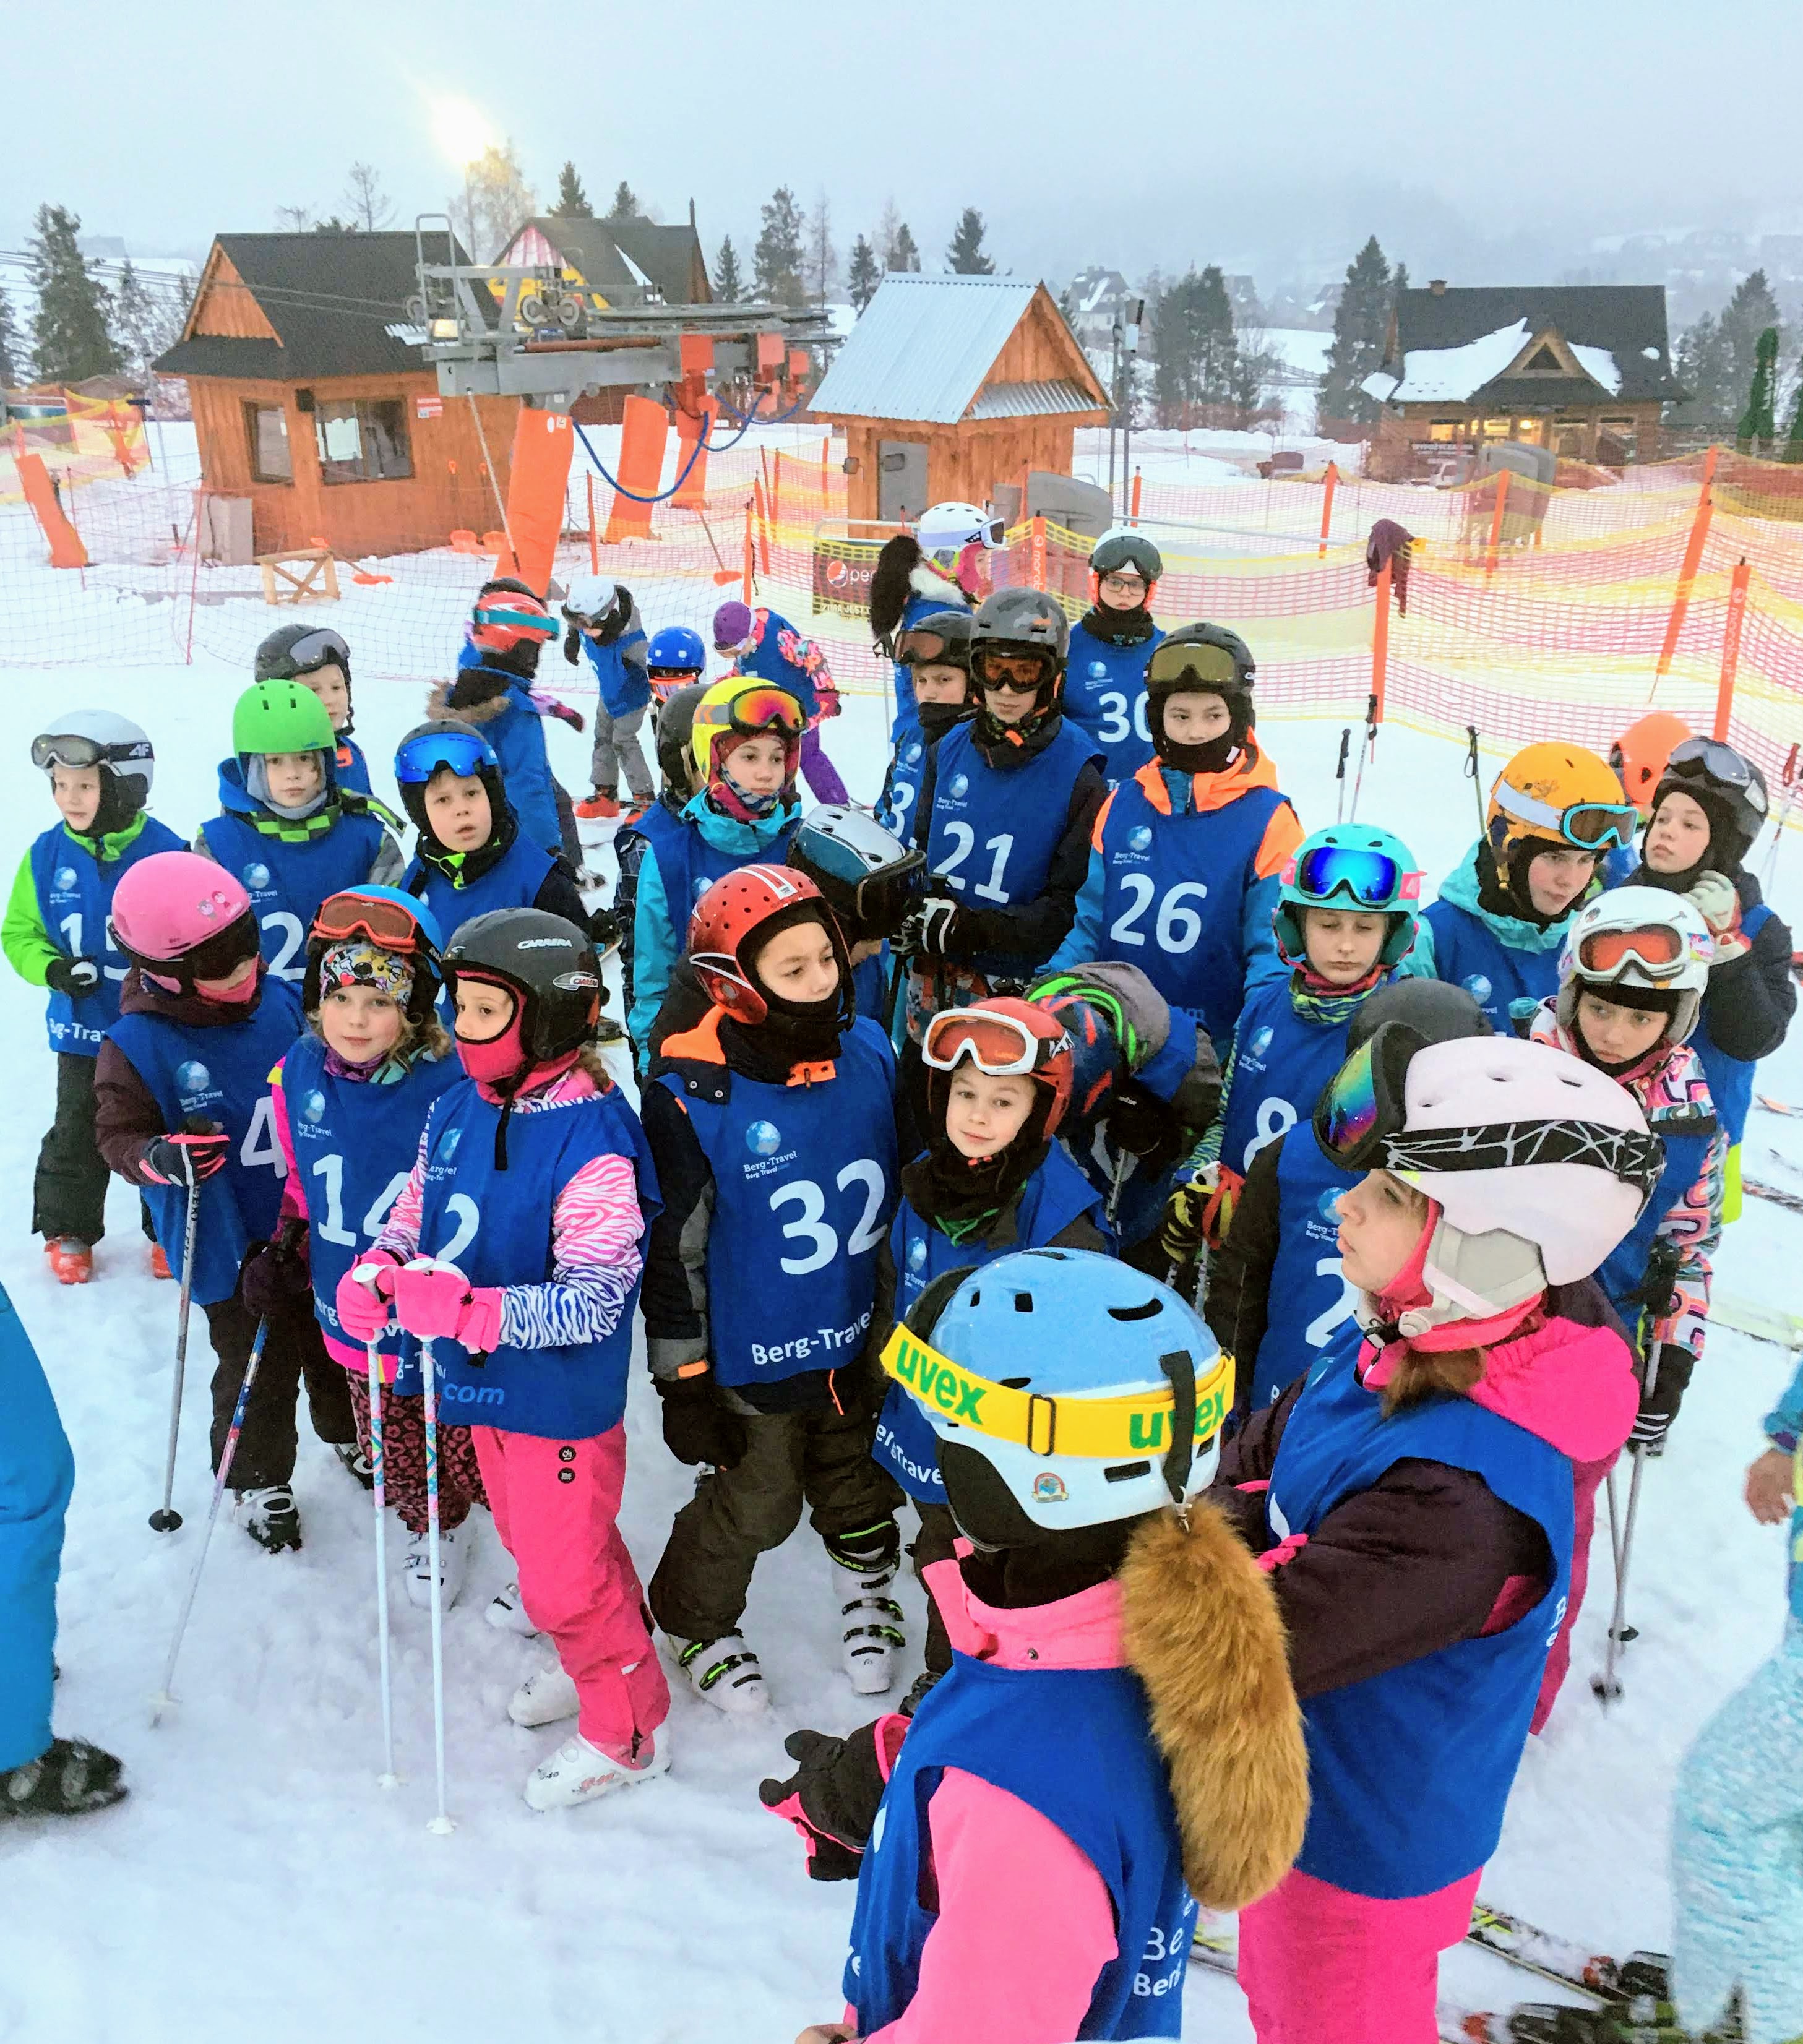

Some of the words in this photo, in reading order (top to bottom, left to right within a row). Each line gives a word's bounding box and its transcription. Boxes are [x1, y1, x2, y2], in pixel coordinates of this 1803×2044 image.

[128, 743, 150, 757] 4F
[933, 821, 1014, 904] 21
[517, 938, 573, 950] CARRERA
[1110, 872, 1208, 954] 26
[239, 1095, 288, 1179] 4
[743, 1150, 798, 1173] Berg-Travel
[769, 1157, 888, 1275] 32
[751, 1301, 875, 1365] Berg-Travel
[896, 1339, 987, 1425] uvex
[1129, 1382, 1226, 1449] uex
